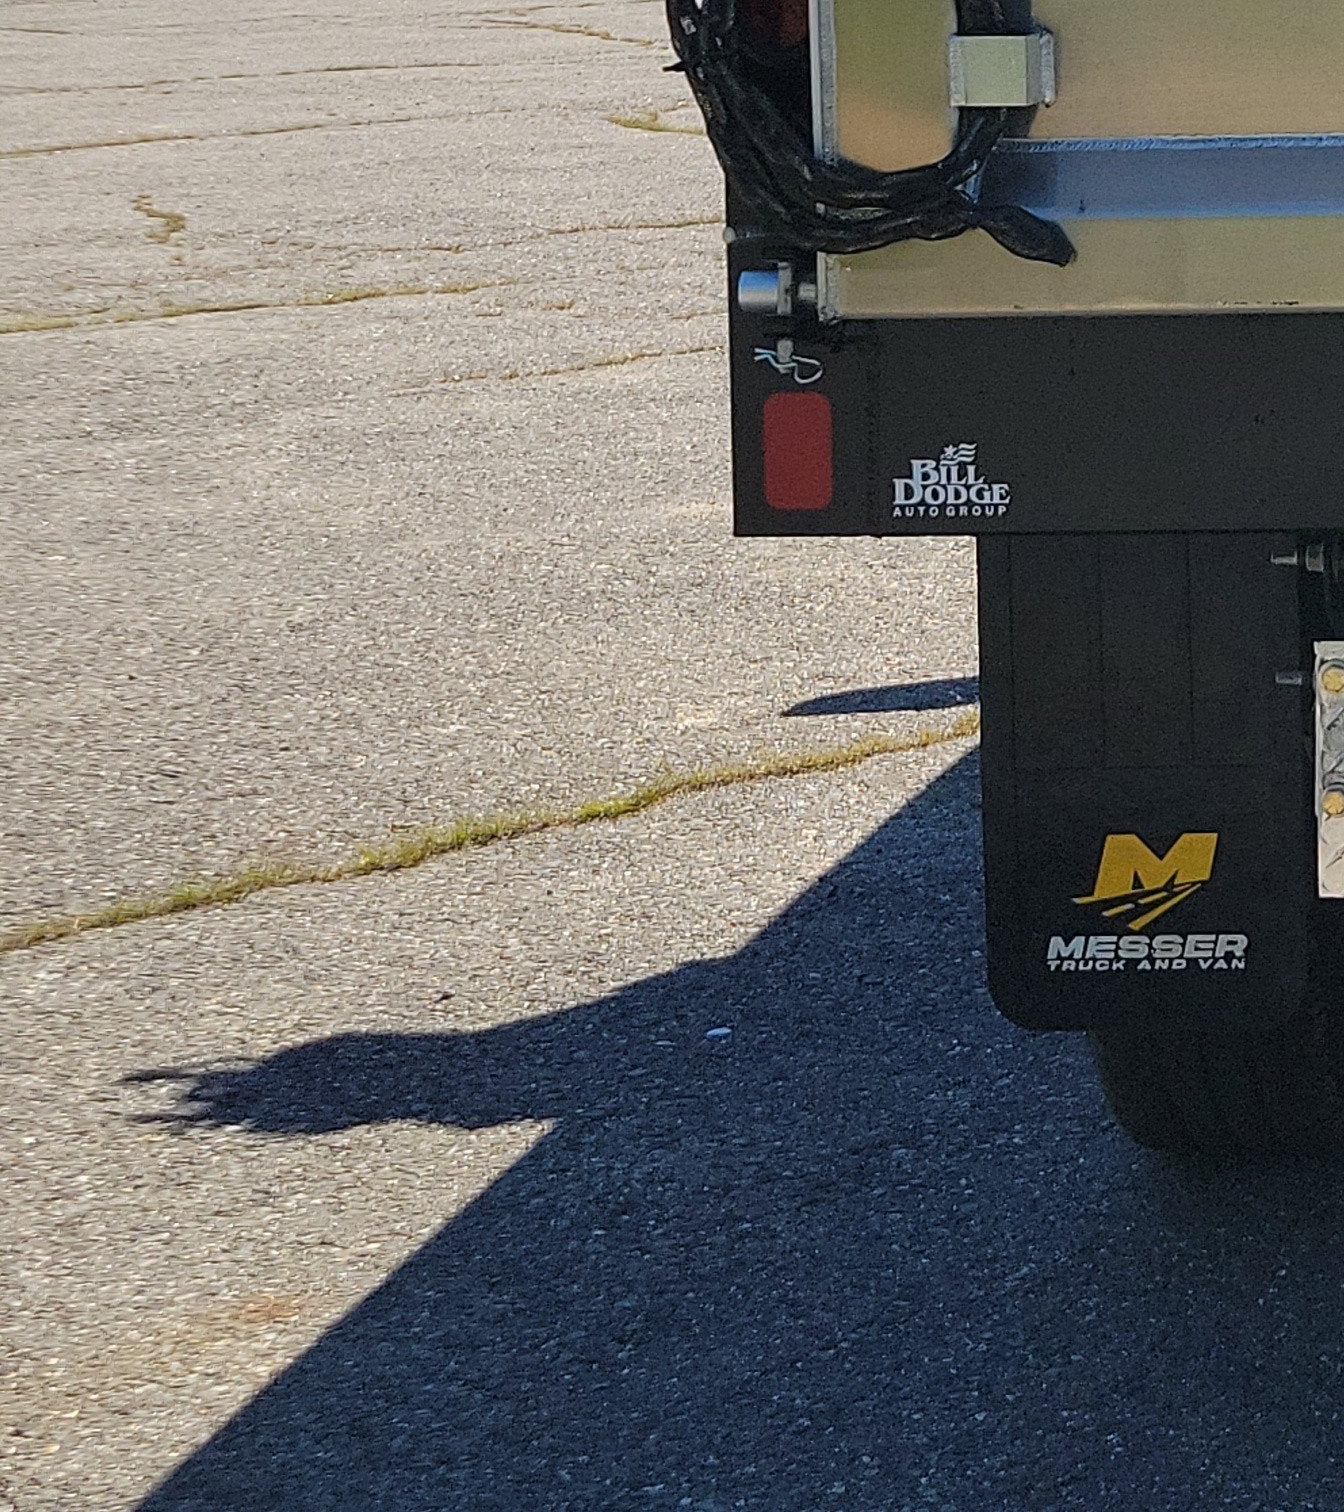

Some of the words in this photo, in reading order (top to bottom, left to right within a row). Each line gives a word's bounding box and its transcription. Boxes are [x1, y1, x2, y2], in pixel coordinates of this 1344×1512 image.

[910, 459, 986, 485] BILL
[892, 478, 1011, 505] DODGE
[892, 506, 939, 517] AUTO
[945, 505, 1007, 517] GROUP
[1046, 934, 1249, 960] MESSER
[1046, 959, 1126, 972] TRUCK
[1136, 958, 1188, 971] AND
[1198, 957, 1247, 970] VAN
